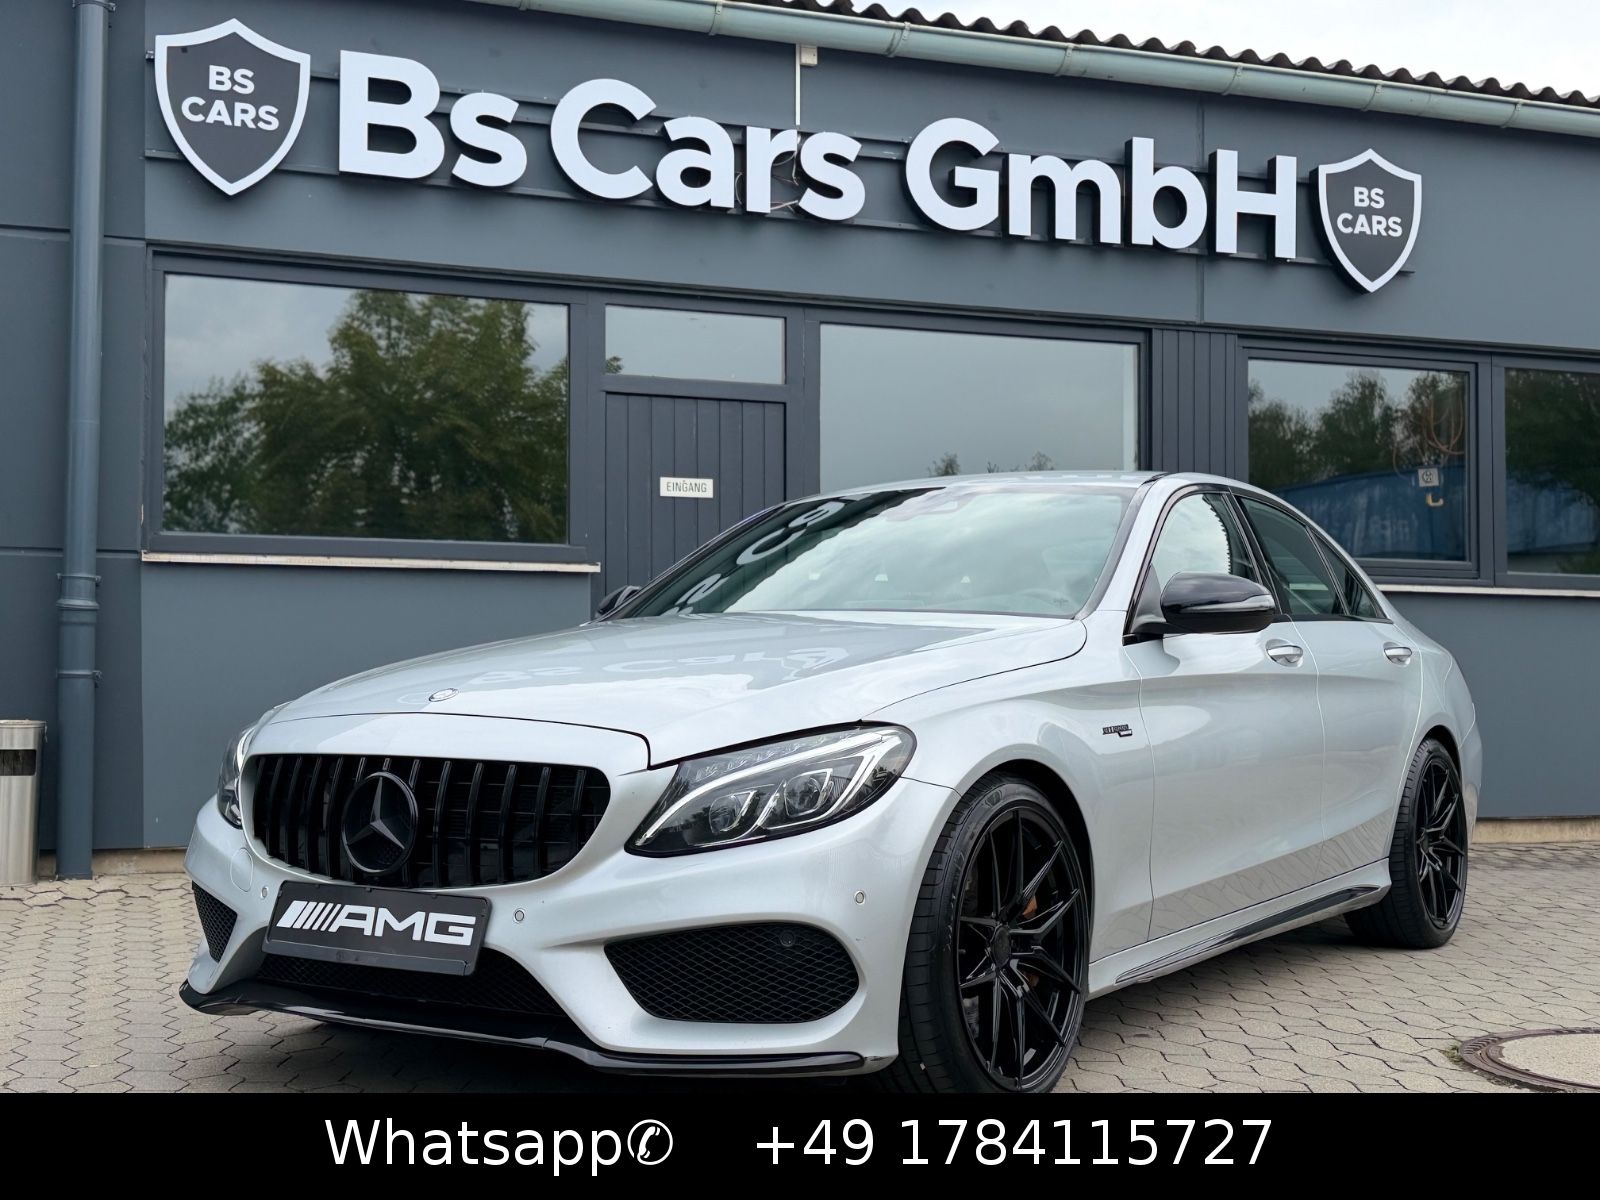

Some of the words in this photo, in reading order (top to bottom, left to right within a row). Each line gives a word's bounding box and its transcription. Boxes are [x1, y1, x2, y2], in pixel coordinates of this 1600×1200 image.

[208, 64, 255, 95] BS
[181, 96, 280, 131] CARS
[339, 49, 528, 187] Bs
[550, 78, 866, 221] Cars
[905, 117, 1297, 259] GmbH
[1353, 186, 1385, 209] BS
[1336, 212, 1403, 238] CARS
[666, 481, 707, 493] EINGANG
[328, 903, 477, 946] AMG
